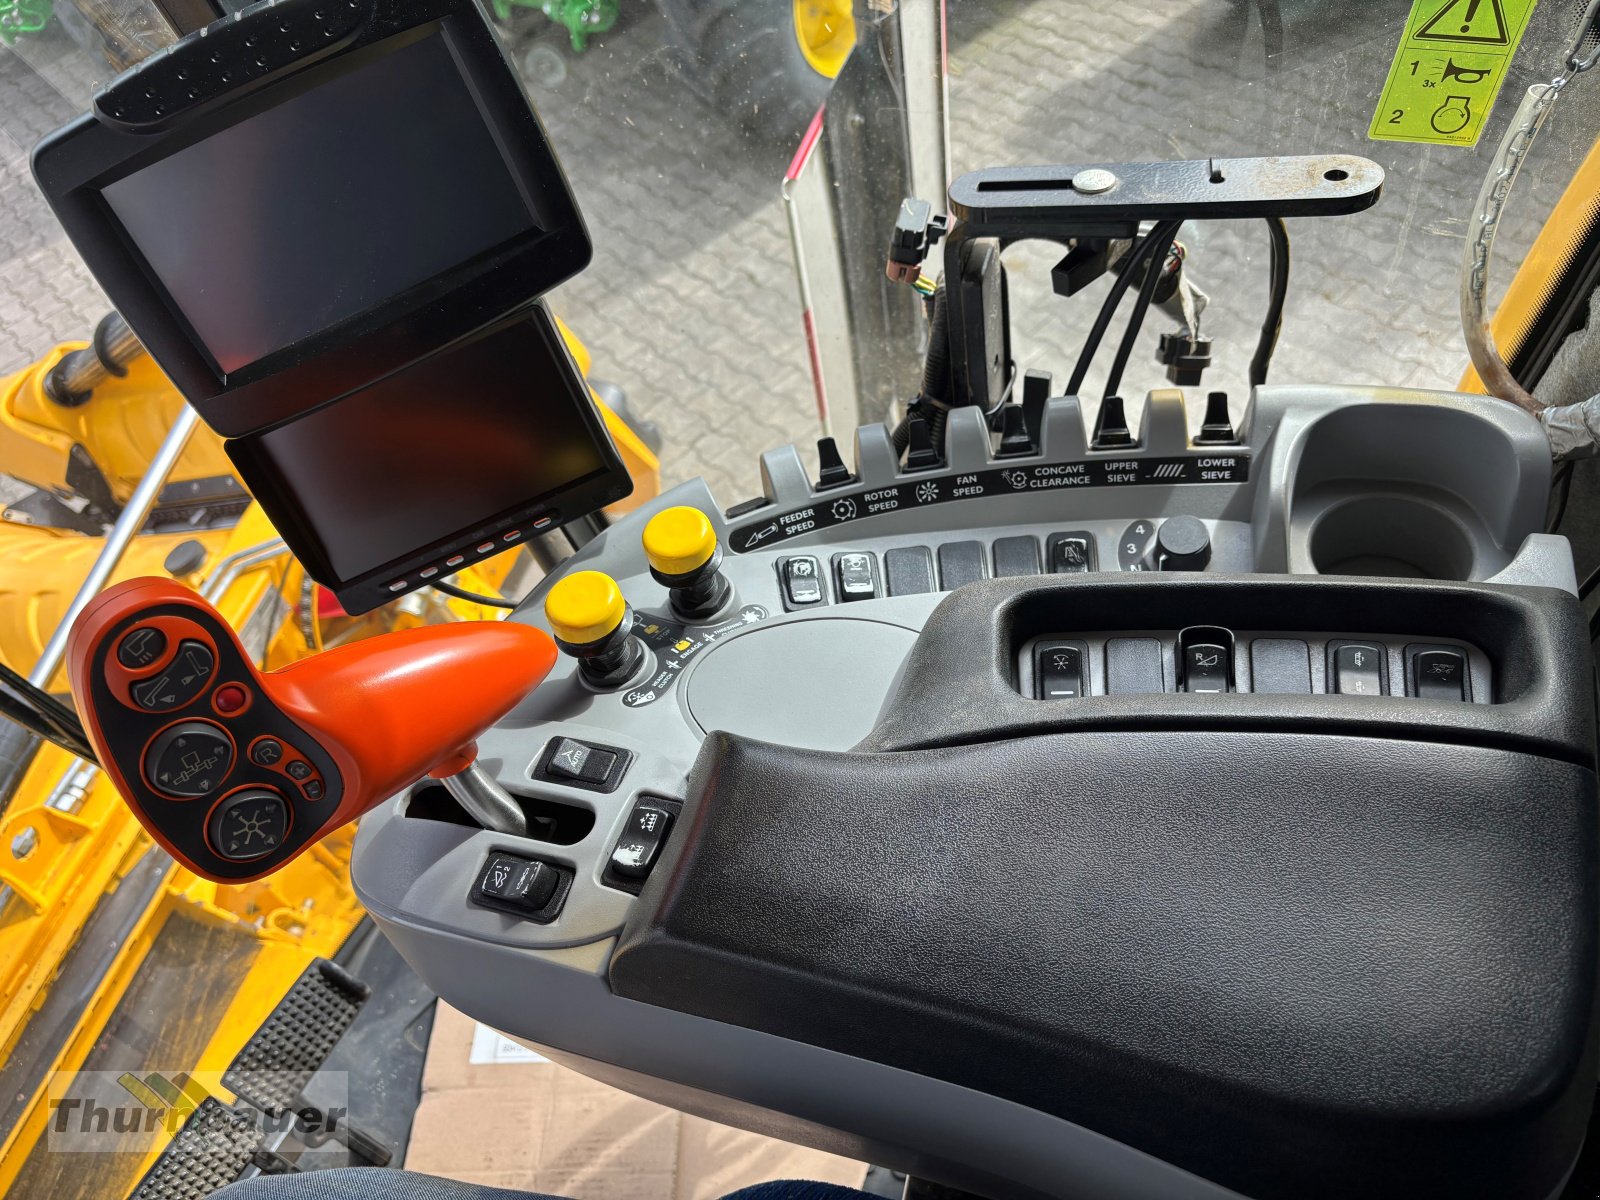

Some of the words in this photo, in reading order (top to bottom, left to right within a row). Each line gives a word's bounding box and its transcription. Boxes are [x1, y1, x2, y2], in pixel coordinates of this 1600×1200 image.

[1410, 60, 1420, 76] 1
[1422, 79, 1436, 89] 3x
[1389, 109, 1404, 124] 2
[1104, 461, 1139, 472] UPPER
[1197, 458, 1236, 468] LOWER
[1034, 464, 1085, 477] CONCAVE
[1201, 470, 1232, 480] SIEVE
[957, 475, 977, 485] FAN
[1029, 475, 1091, 488] CLEARANCE
[1107, 473, 1137, 483] SIEVE
[864, 488, 899, 502] ROTOR
[952, 485, 984, 497] SPEED
[868, 500, 898, 513] SPEED
[779, 508, 815, 525] FEEDER
[785, 520, 815, 536] SPEED
[1135, 524, 1145, 535] 4
[1127, 543, 1137, 554] 3
[680, 642, 703, 659] ENGAGE
[1195, 653, 1203, 661] R
[652, 671, 668, 687] HEADER
[658, 674, 673, 688] CLUTCH
[260, 747, 278, 762] R
[571, 750, 583, 767] AUTO
